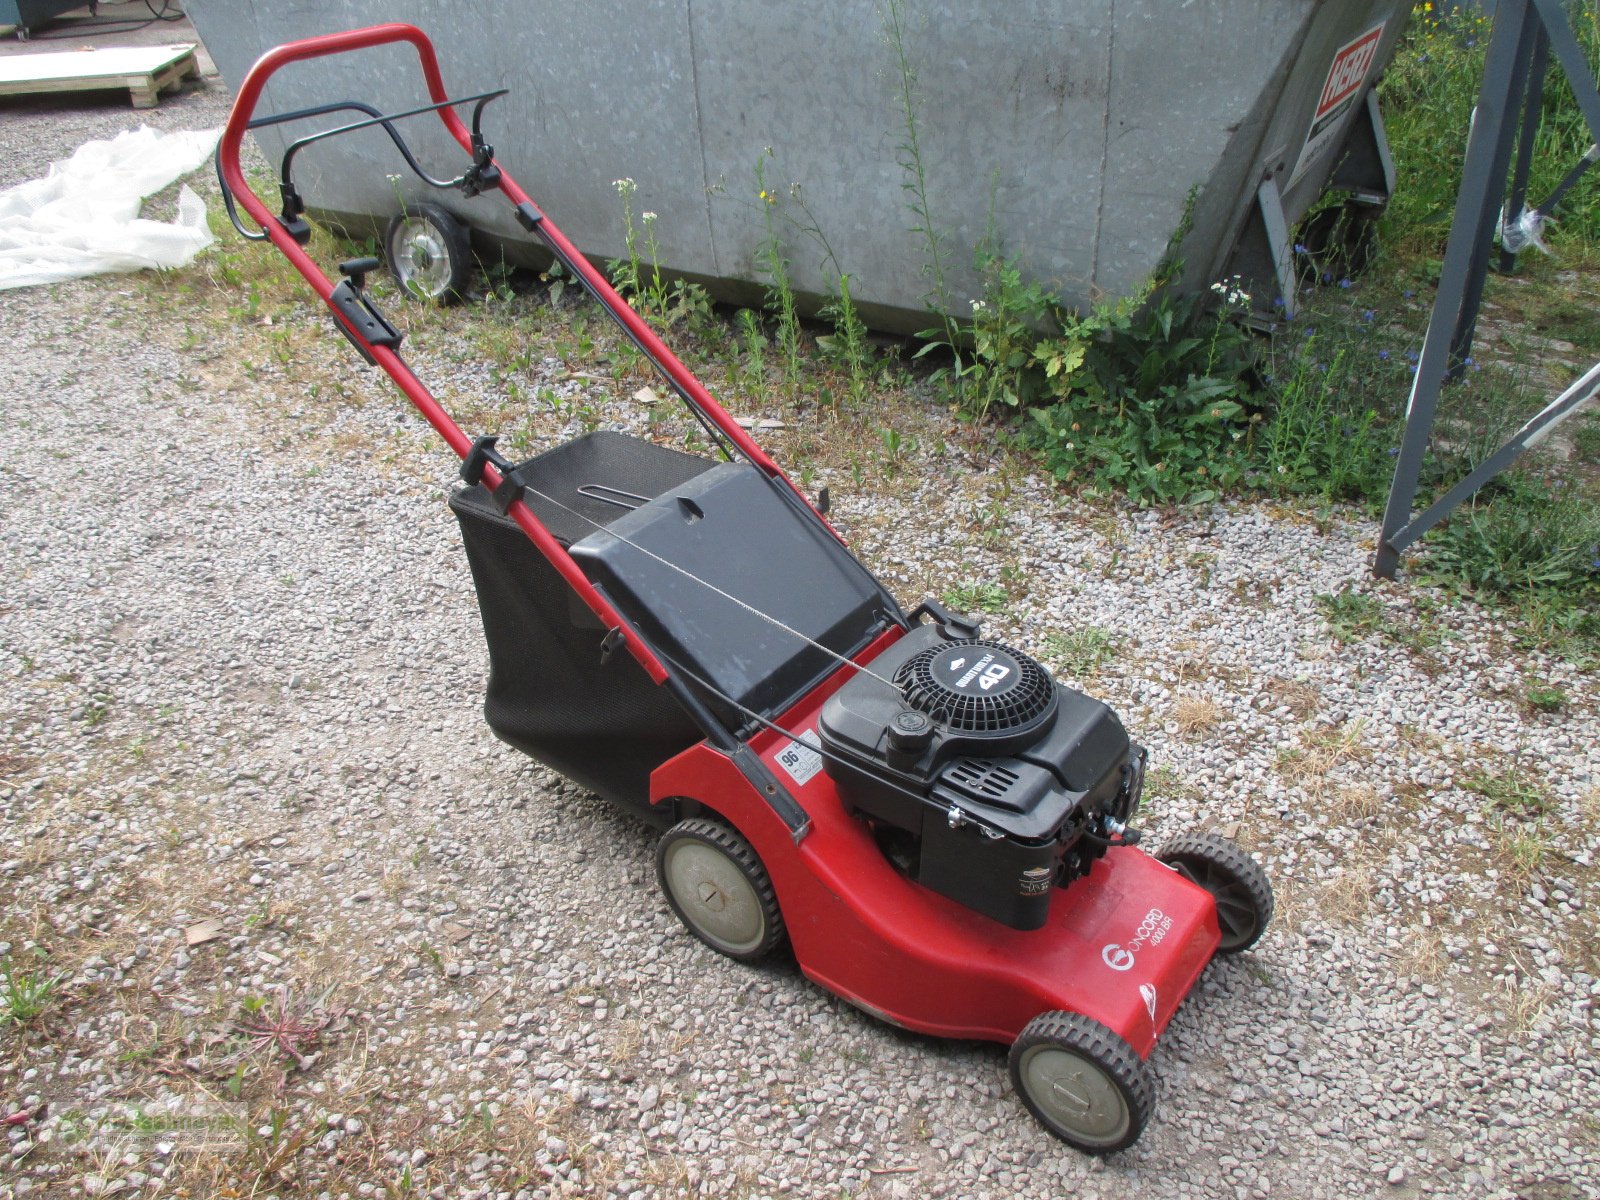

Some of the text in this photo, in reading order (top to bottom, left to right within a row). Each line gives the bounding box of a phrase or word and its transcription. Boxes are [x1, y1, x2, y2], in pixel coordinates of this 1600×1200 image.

[978, 663, 1010, 690] 40
[781, 751, 799, 767] 96
[1150, 915, 1175, 947] 4000 BR
